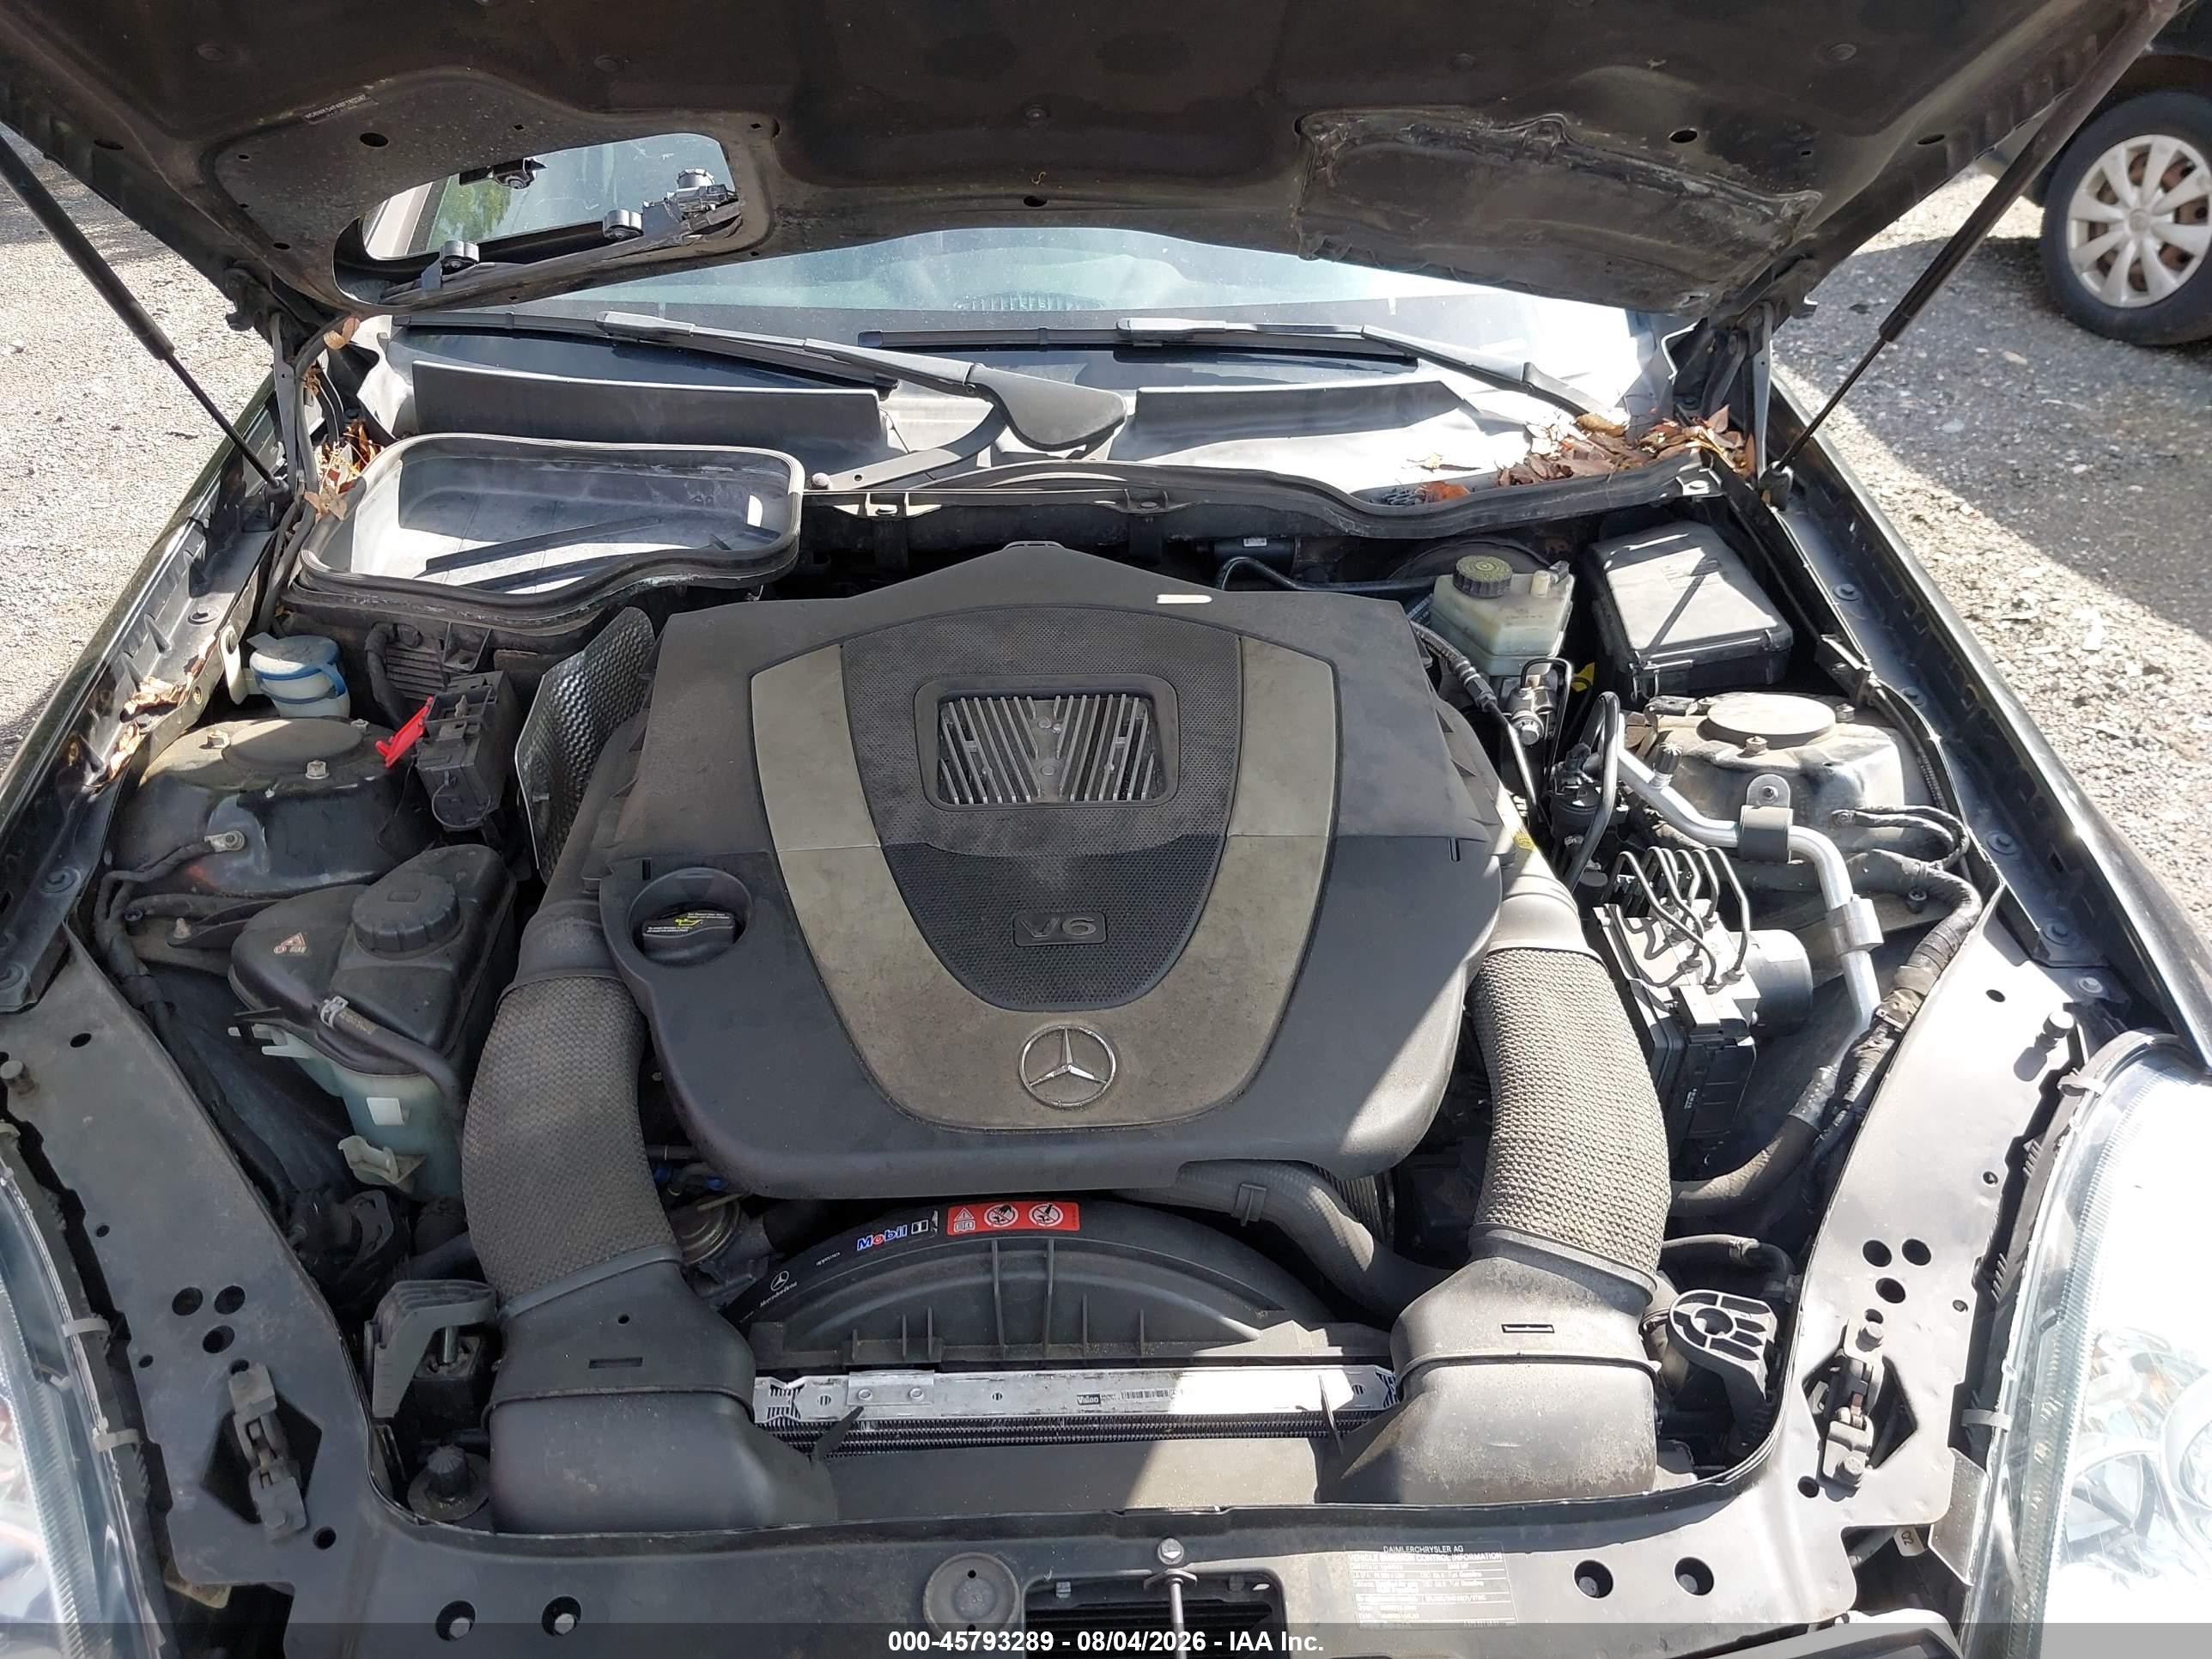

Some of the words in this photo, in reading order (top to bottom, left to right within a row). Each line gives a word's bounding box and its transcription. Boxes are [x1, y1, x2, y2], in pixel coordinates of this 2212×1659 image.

[1019, 917, 1097, 938] V6
[857, 1224, 908, 1251] Mobil
[1077, 1395, 1099, 1405] Valeo
[1382, 1545, 1451, 1553] DAIMLERCHRYSLER
